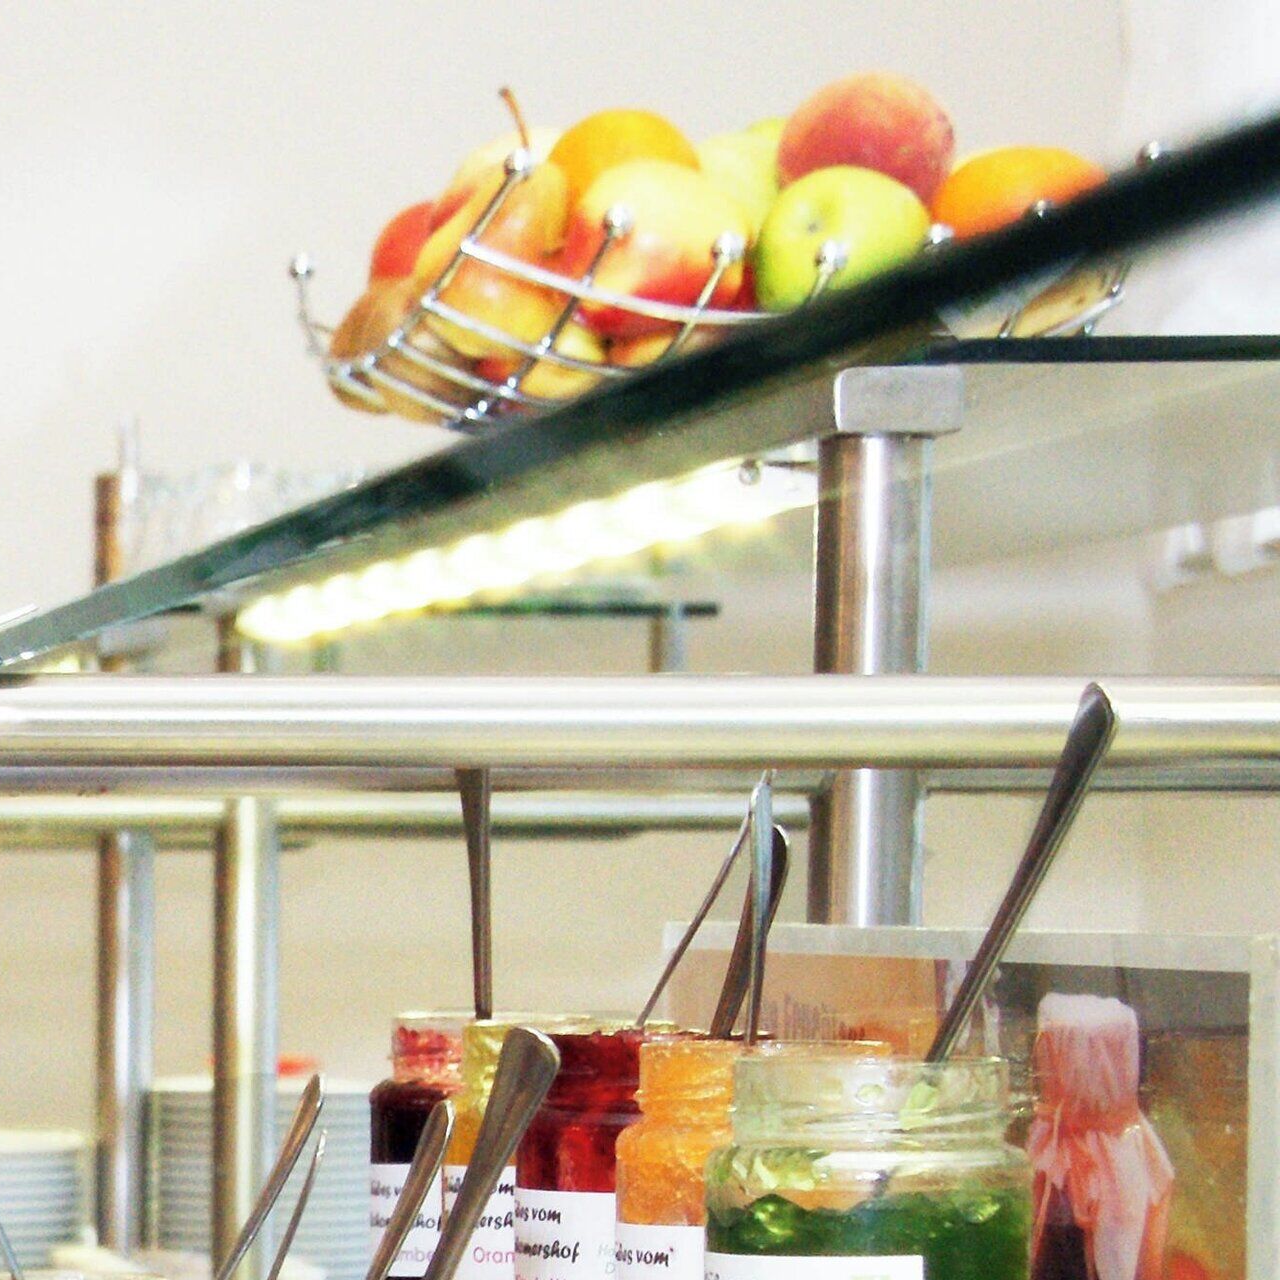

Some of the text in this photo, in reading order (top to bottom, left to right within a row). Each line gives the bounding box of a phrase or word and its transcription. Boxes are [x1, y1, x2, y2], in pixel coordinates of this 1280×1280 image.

[532, 1207, 562, 1224] vom
[473, 1246, 516, 1264] Oran
[636, 1250, 669, 1267] vom
